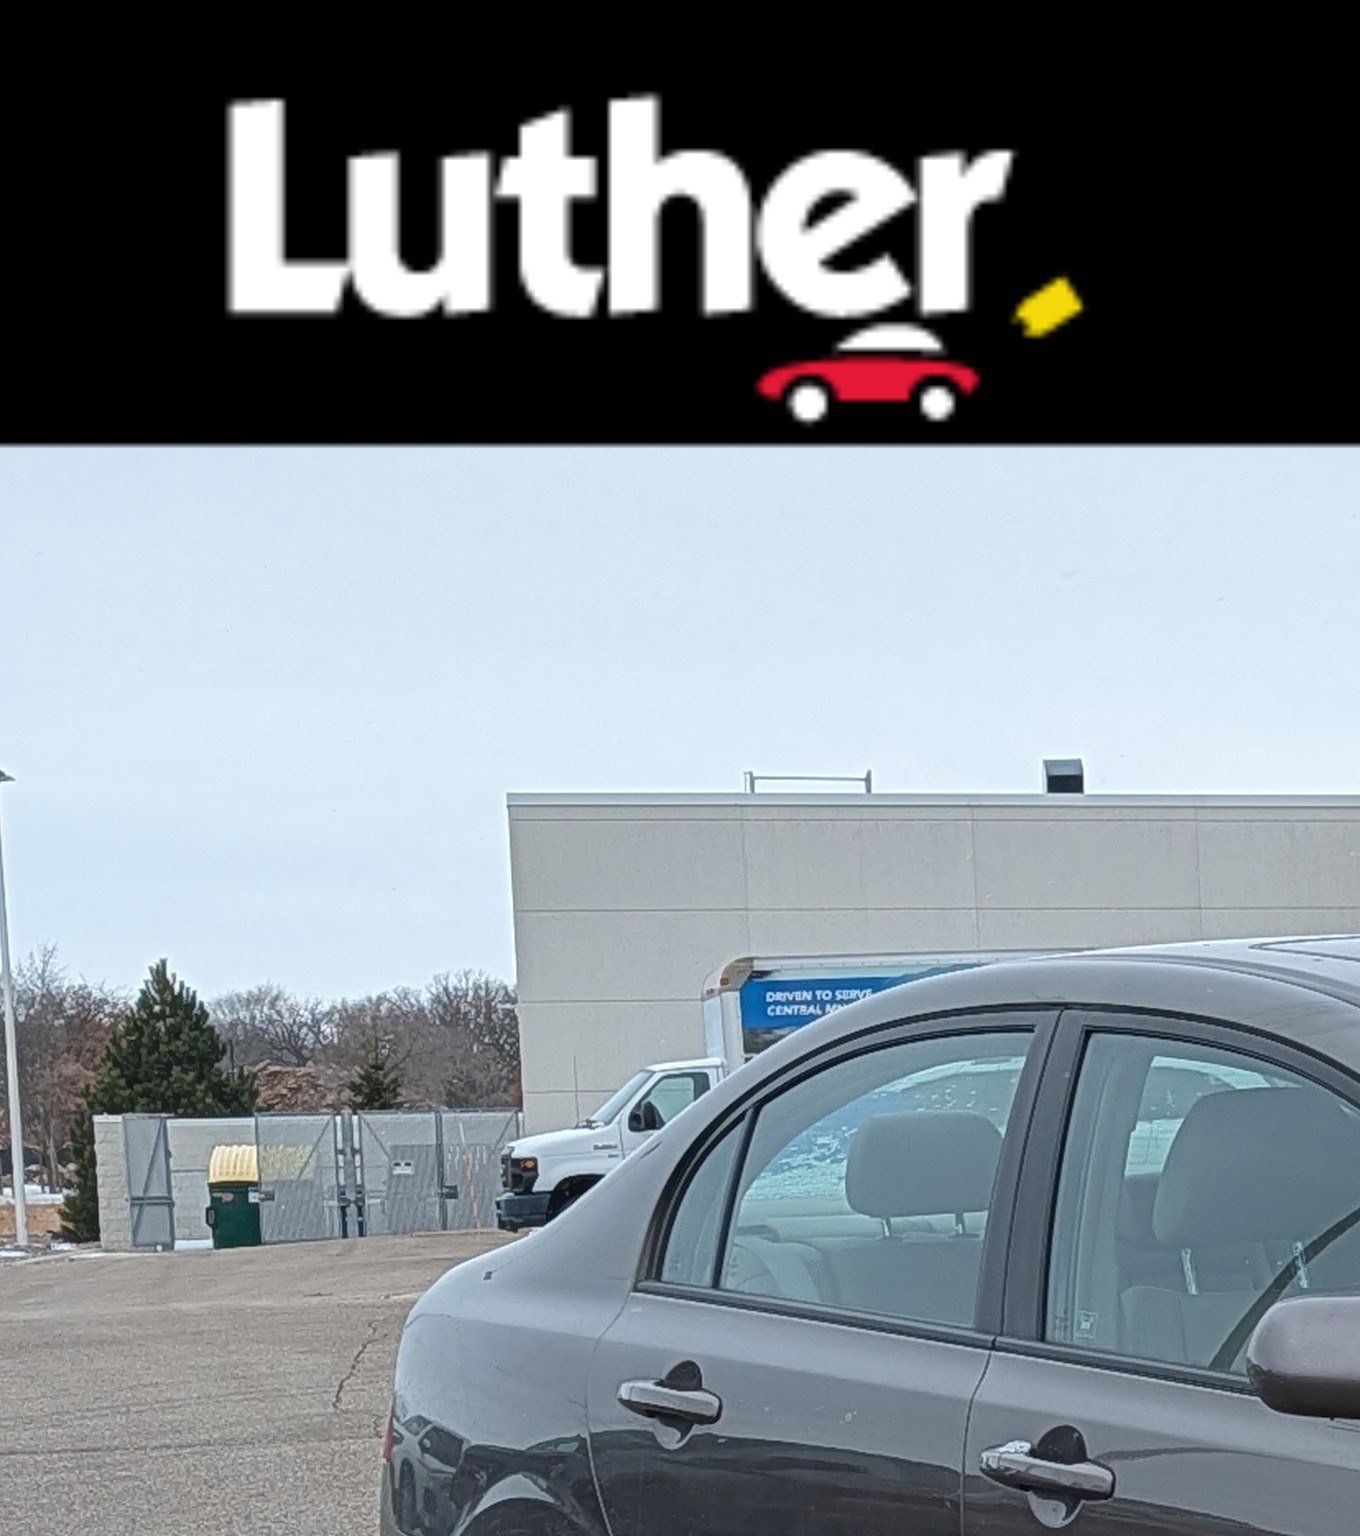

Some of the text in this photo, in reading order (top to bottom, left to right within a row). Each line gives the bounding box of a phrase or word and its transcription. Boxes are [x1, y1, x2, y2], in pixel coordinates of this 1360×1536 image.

[765, 990, 812, 1002] DRIVEN
[815, 989, 832, 1001] TO
[767, 1003, 823, 1016] CENTRAL
